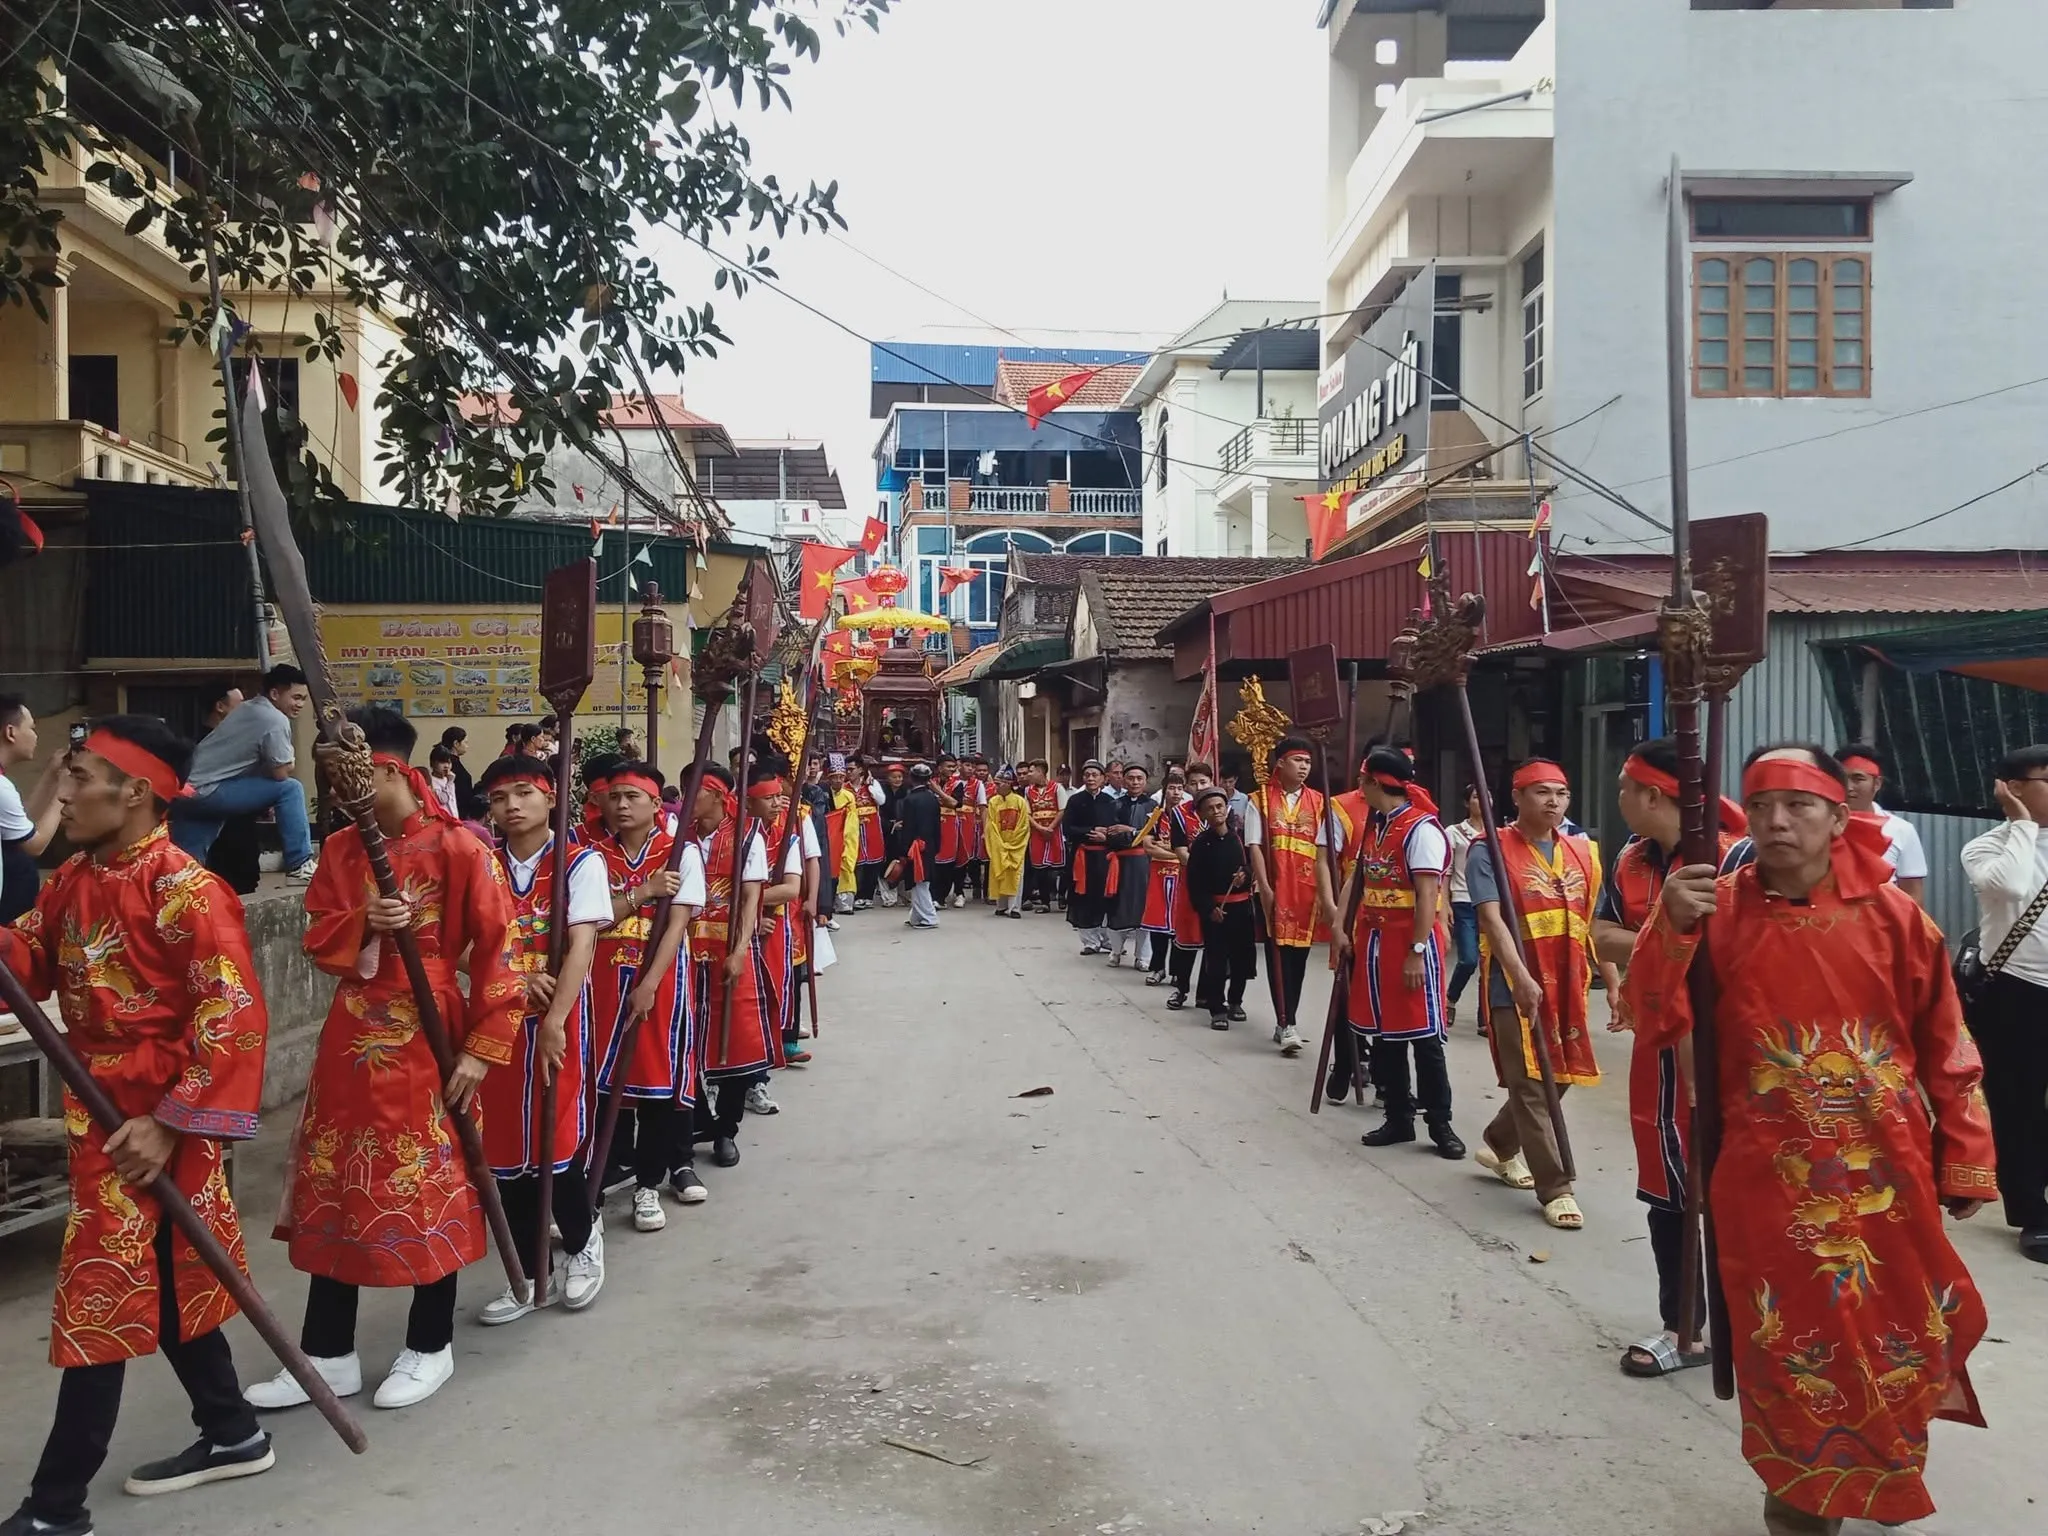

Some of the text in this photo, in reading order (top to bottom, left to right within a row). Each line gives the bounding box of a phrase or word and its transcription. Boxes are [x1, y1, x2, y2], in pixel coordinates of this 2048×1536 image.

[1320, 378, 1382, 480] QUANG
[380, 621, 462, 638] Bánh
[375, 645, 426, 659] TRỘN
[444, 644, 480, 657] TRÀ
